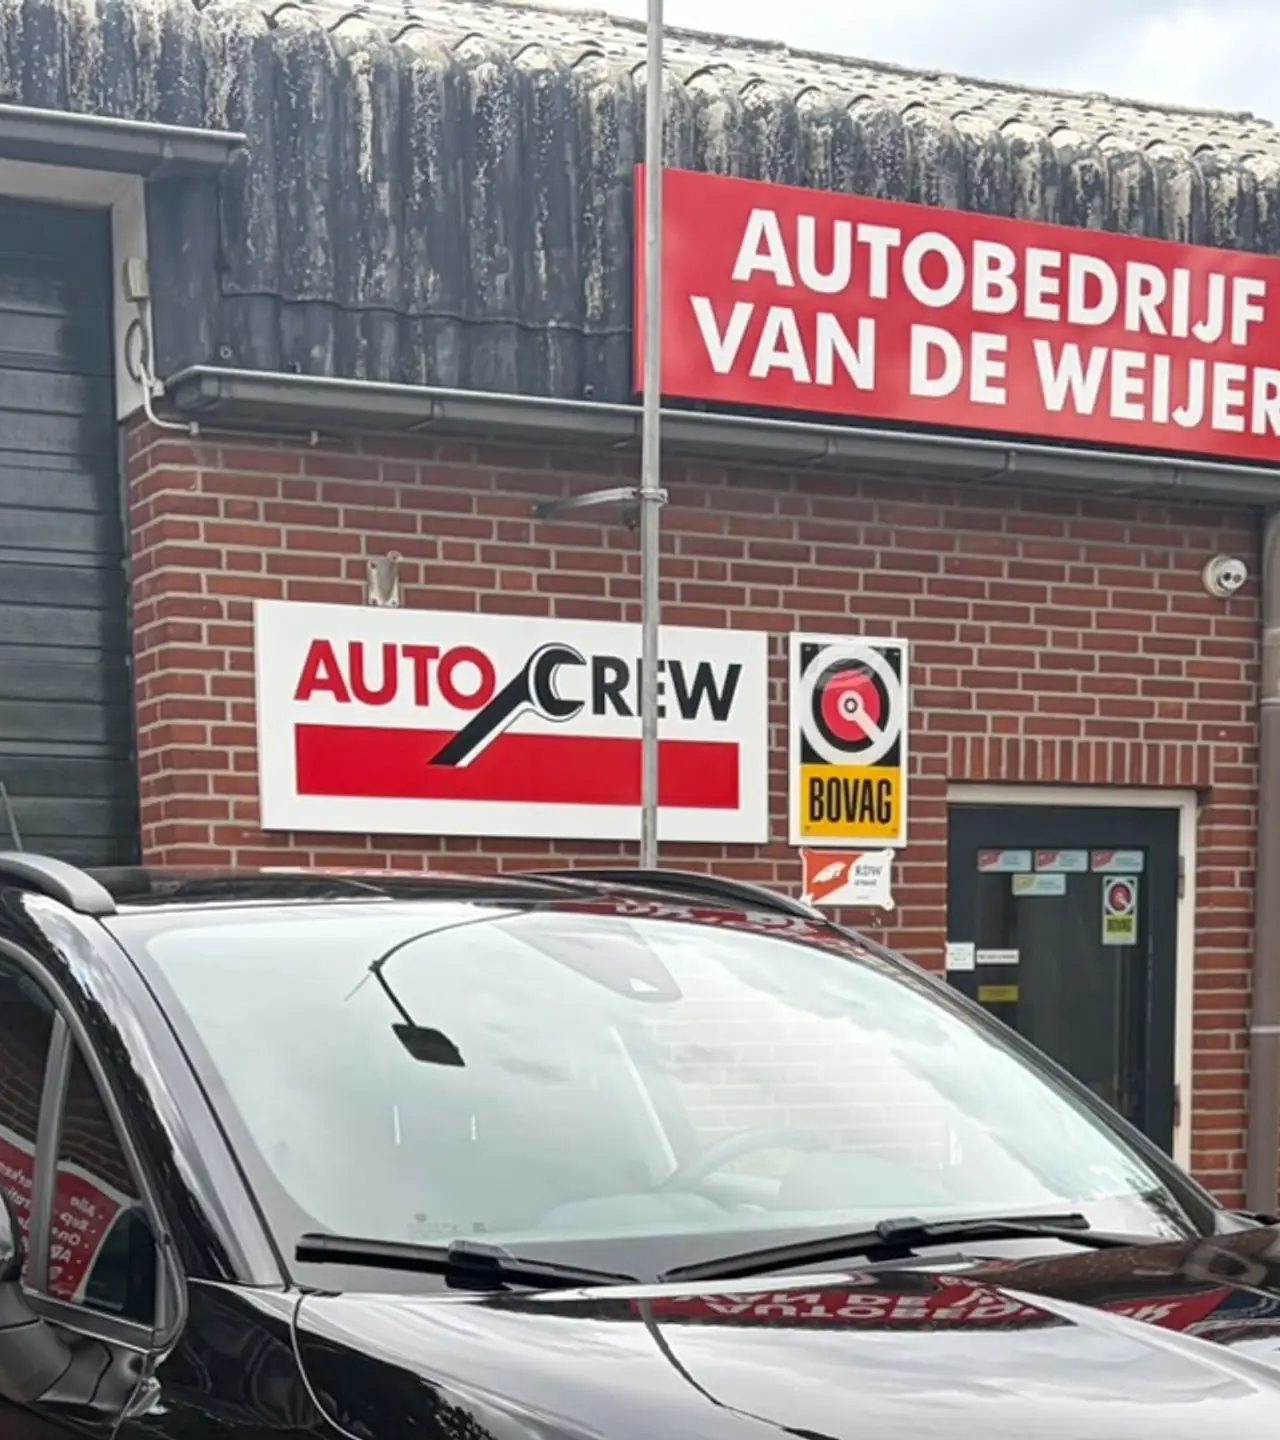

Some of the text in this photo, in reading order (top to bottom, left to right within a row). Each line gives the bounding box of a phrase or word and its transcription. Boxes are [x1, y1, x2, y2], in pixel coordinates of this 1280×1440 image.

[731, 207, 1268, 347] AUTOBEDRIJF
[690, 295, 876, 391] VAN
[908, 323, 1008, 405] DE
[293, 638, 497, 711] AUTO
[809, 776, 892, 824] BOVAG
